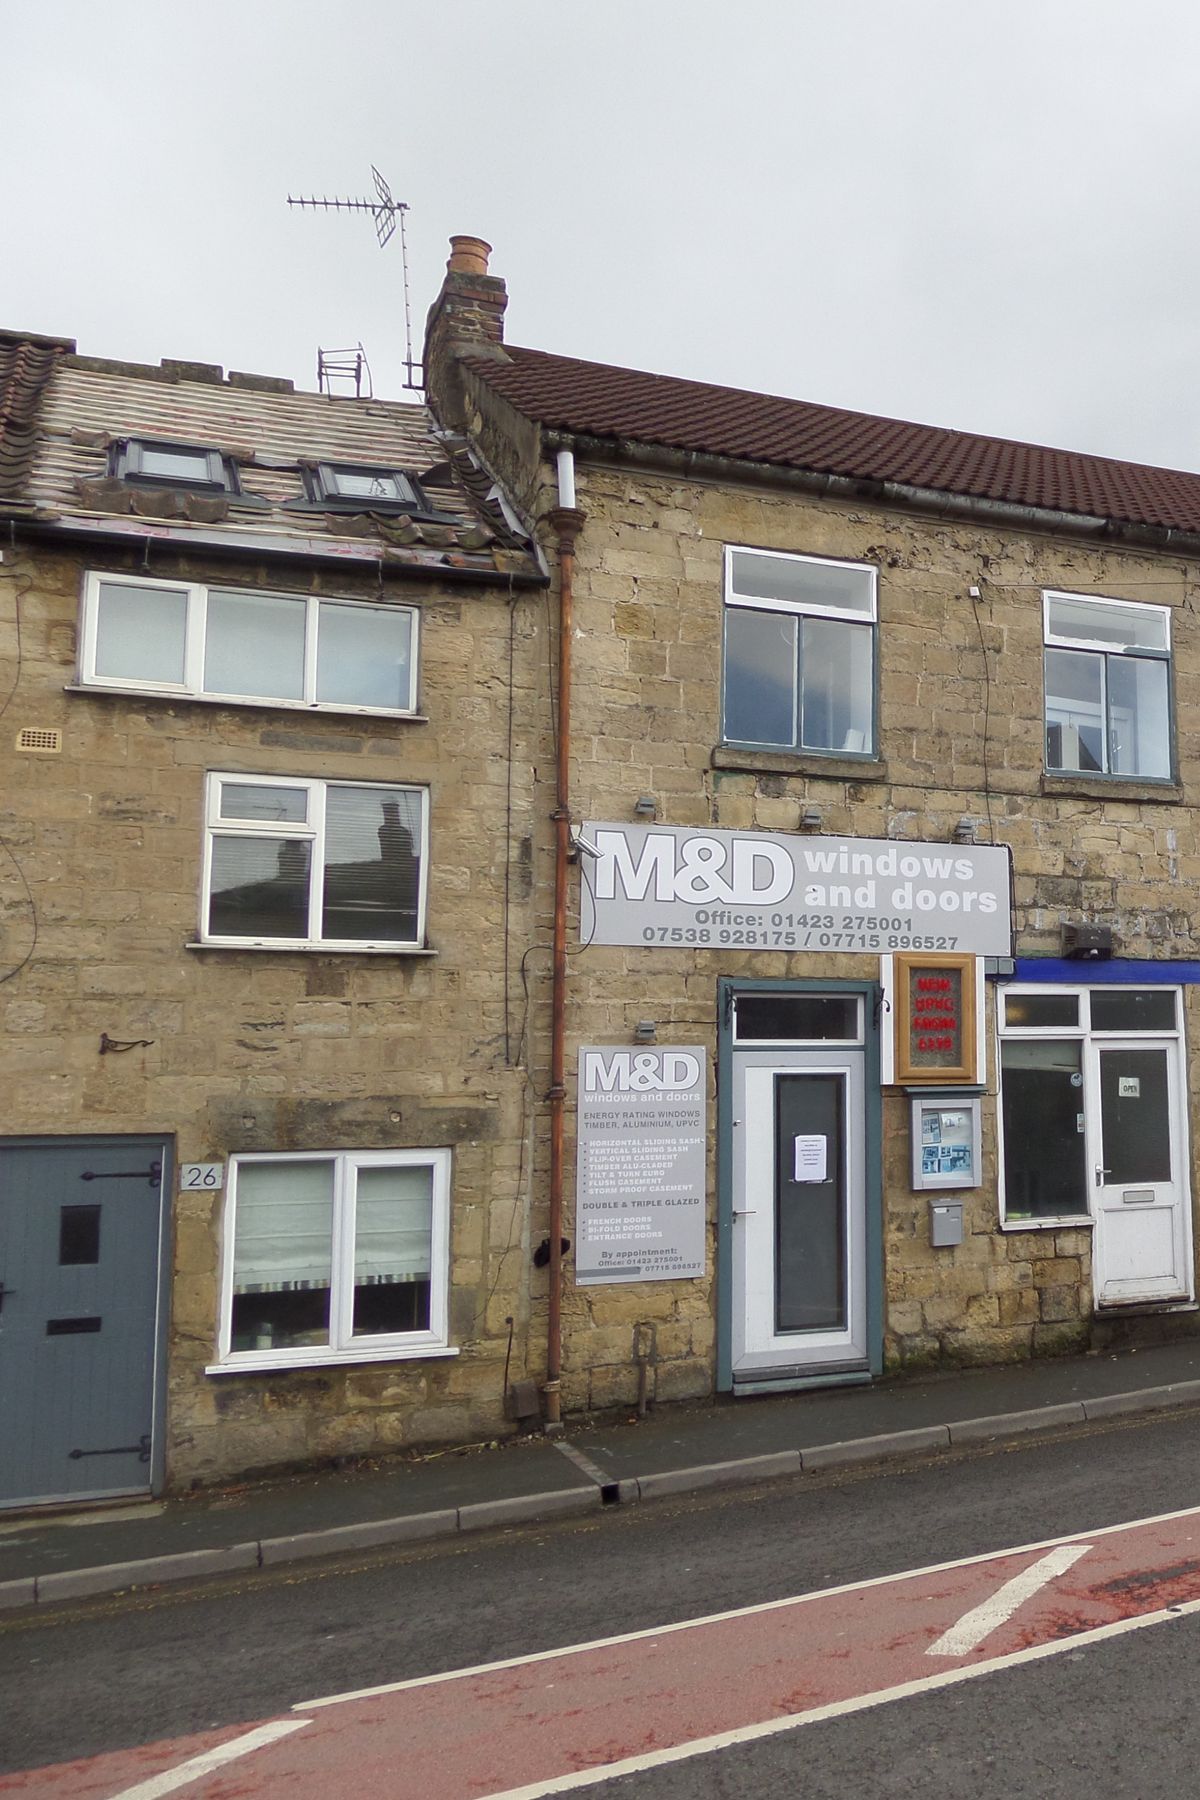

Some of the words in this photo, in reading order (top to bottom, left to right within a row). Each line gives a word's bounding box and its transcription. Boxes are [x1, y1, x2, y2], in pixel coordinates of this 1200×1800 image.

[595, 830, 795, 905] M&D
[804, 846, 974, 880] windows
[804, 881, 876, 909] and
[892, 883, 998, 913] doors
[695, 910, 763, 927] Office:
[771, 914, 834, 929] 01423
[842, 916, 913, 932] 275001
[642, 926, 711, 943] 07538
[719, 929, 796, 946] 928175
[819, 933, 881, 948] 07715
[888, 935, 959, 950] 896527
[585, 1052, 700, 1092] M&D
[1123, 1085, 1138, 1093] OPEN
[584, 1093, 637, 1103] windows
[641, 1093, 662, 1102] and
[666, 1092, 701, 1102] doors
[623, 1111, 655, 1119] RATING
[658, 1110, 700, 1118] WINDOWS
[590, 1140, 641, 1148] HORIZONTAL
[644, 1138, 676, 1146] SLIDING
[590, 1147, 630, 1155] VERTICAL
[632, 1146, 664, 1154] SLIDING
[188, 1168, 215, 1186] 26
[618, 1178, 662, 1186] CASEMENT
[588, 1187, 617, 1195] STORM
[649, 1184, 694, 1192] CASEMENT
[582, 1201, 618, 1210] DOUBLE
[631, 1200, 662, 1208] TRIPLE
[664, 1198, 700, 1206] GLAZED
[623, 1216, 652, 1224] DOORS
[623, 1224, 651, 1232] DOORS
[588, 1233, 632, 1241] ENTRANCE
[635, 1231, 663, 1239] DOORS
[601, 1251, 613, 1259] By
[616, 1248, 677, 1258] appointment:
